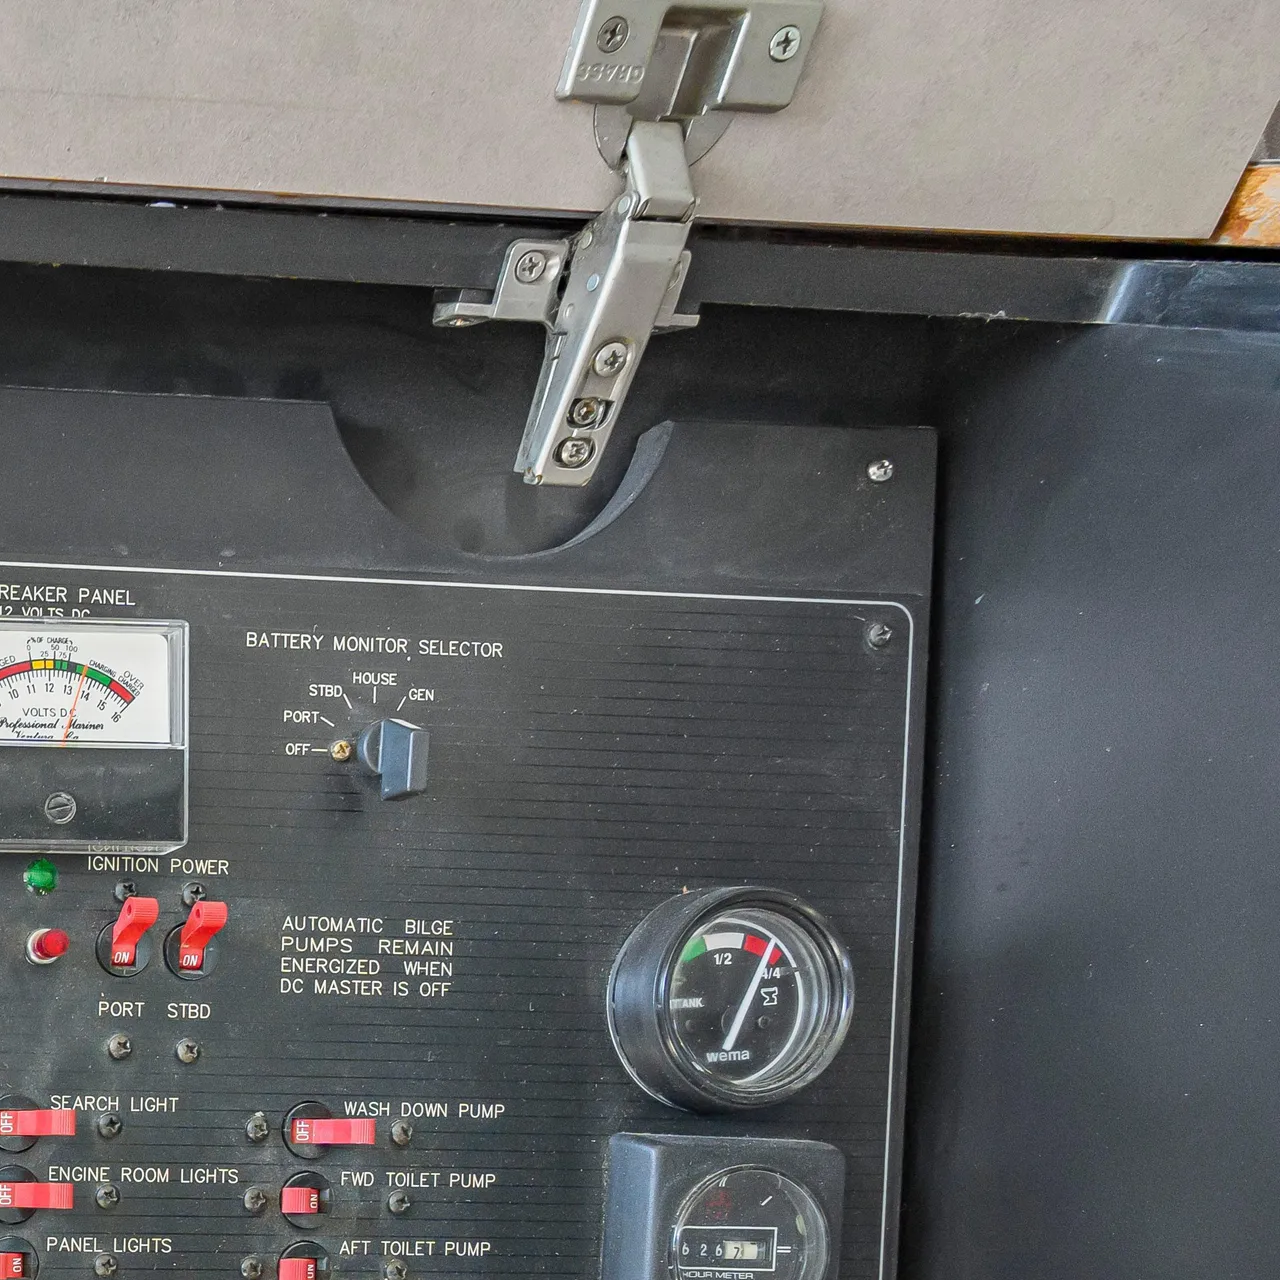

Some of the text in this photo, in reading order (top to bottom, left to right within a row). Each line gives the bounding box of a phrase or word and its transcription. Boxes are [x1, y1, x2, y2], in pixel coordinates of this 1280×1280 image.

[78, 587, 136, 606] PANEL
[246, 631, 503, 658] BATTERY MONITOR SELECTOR
[44, 682, 55, 694] 12
[352, 671, 398, 686] HOUSE
[308, 683, 343, 698] STBD
[283, 709, 320, 724] PORT
[87, 855, 229, 875] IGNITION POWER
[280, 956, 453, 977] ENERGIZED WHEN
[713, 952, 733, 966] 1/2
[706, 1049, 750, 1063] wema
[50, 1094, 180, 1113] SEARCH LIGHT
[343, 1100, 505, 1119] WASH DOWN PUMP
[0, 1111, 14, 1133] OFF
